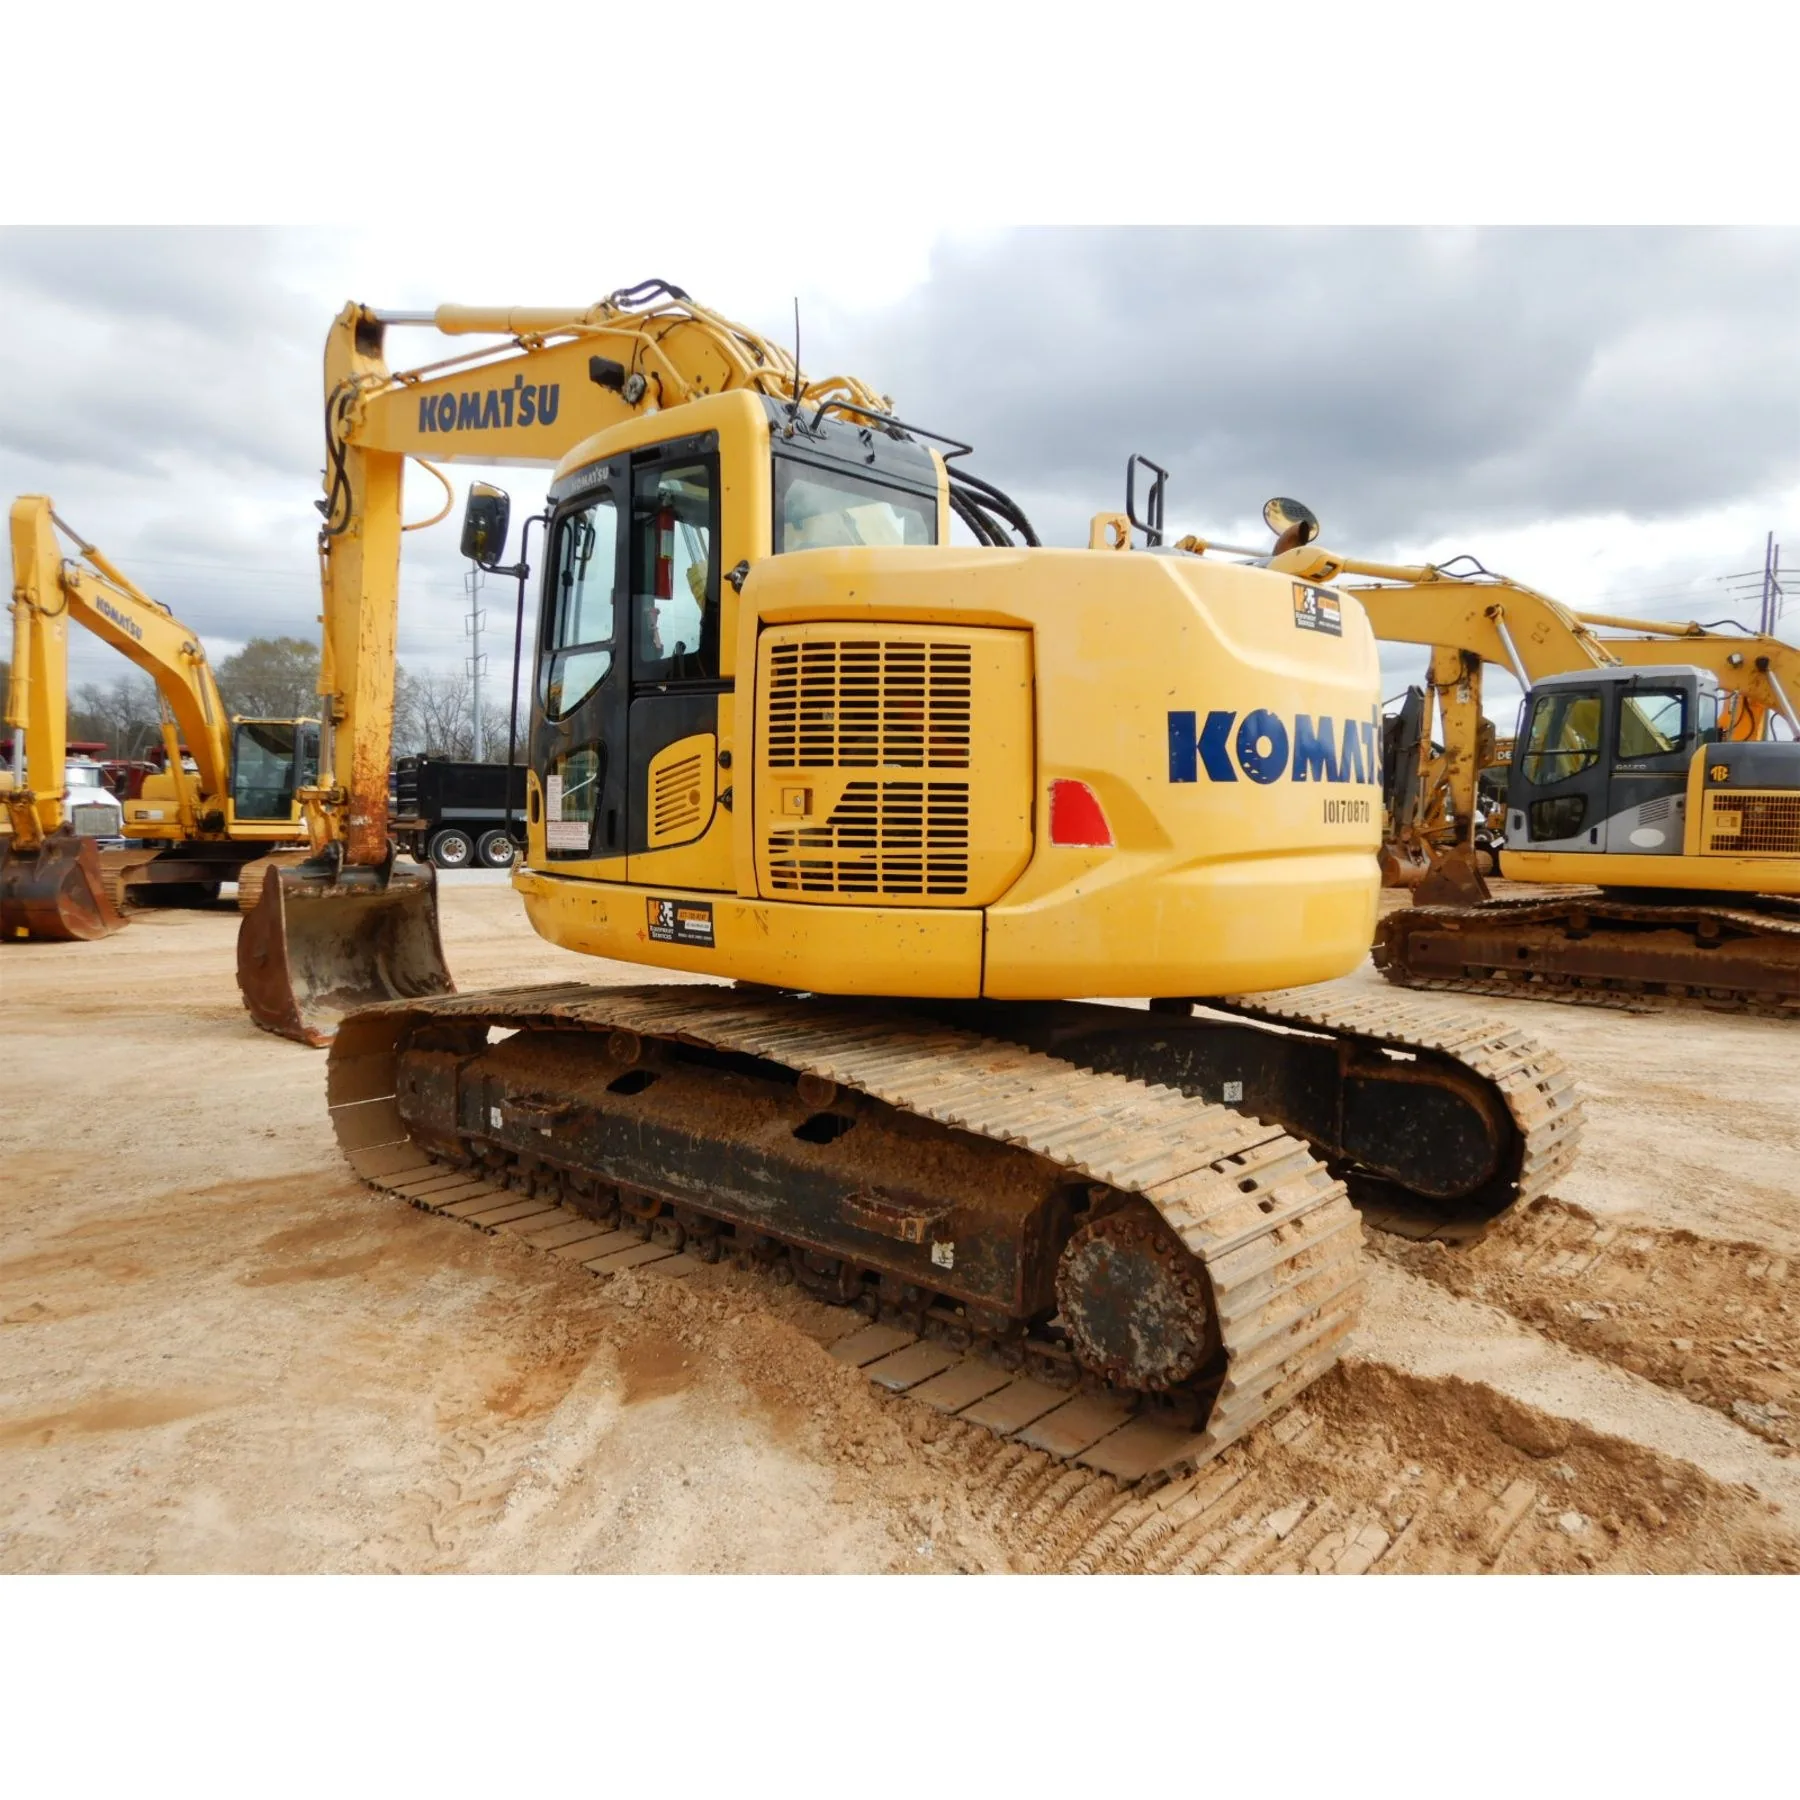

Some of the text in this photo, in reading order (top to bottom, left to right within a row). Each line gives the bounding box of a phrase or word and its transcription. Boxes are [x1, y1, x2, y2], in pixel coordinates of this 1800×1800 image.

[419, 374, 560, 433] KOMATSU
[95, 594, 143, 641] KOMATSU
[1323, 799, 1370, 825] 10170870
